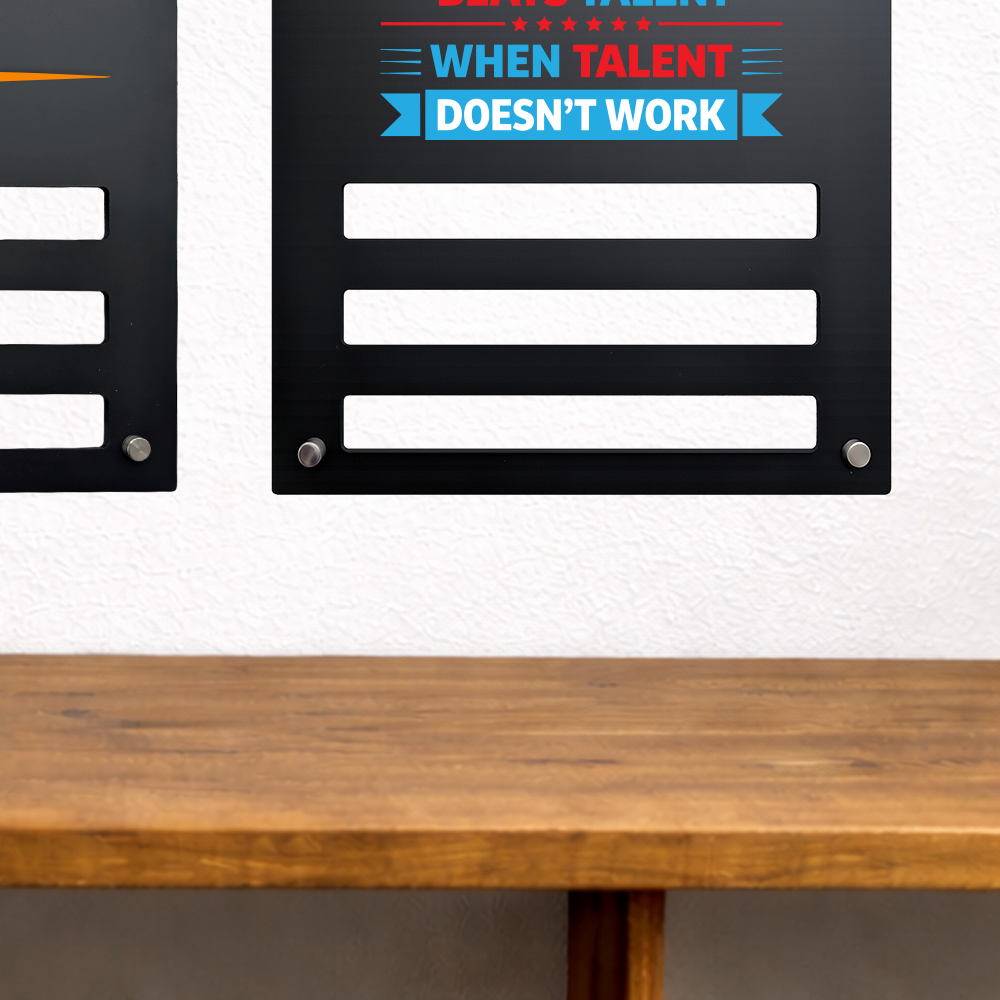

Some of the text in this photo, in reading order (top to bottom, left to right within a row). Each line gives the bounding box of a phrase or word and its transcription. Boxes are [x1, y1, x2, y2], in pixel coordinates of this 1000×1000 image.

[430, 44, 732, 77] WHEN TALENT
[438, 99, 724, 131] DOESN'T WORK
